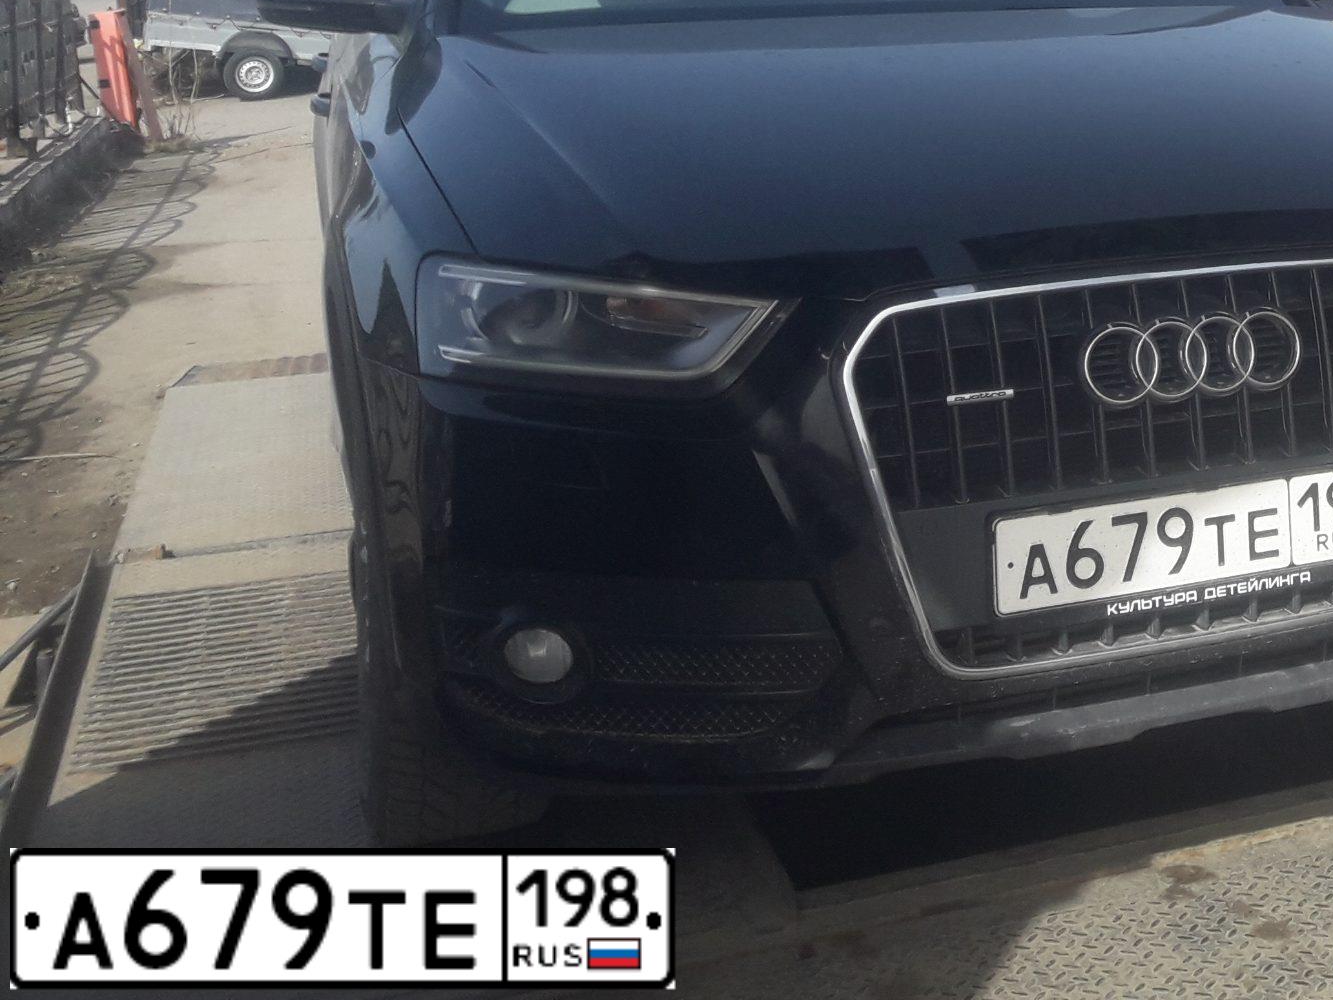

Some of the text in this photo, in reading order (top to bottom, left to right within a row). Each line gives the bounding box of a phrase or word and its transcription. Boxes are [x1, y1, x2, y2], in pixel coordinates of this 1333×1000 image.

[954, 391, 1007, 402] quattro
[1107, 571, 1312, 617] КУЛЬТУРА ДЕТЕЙЛИНГА
